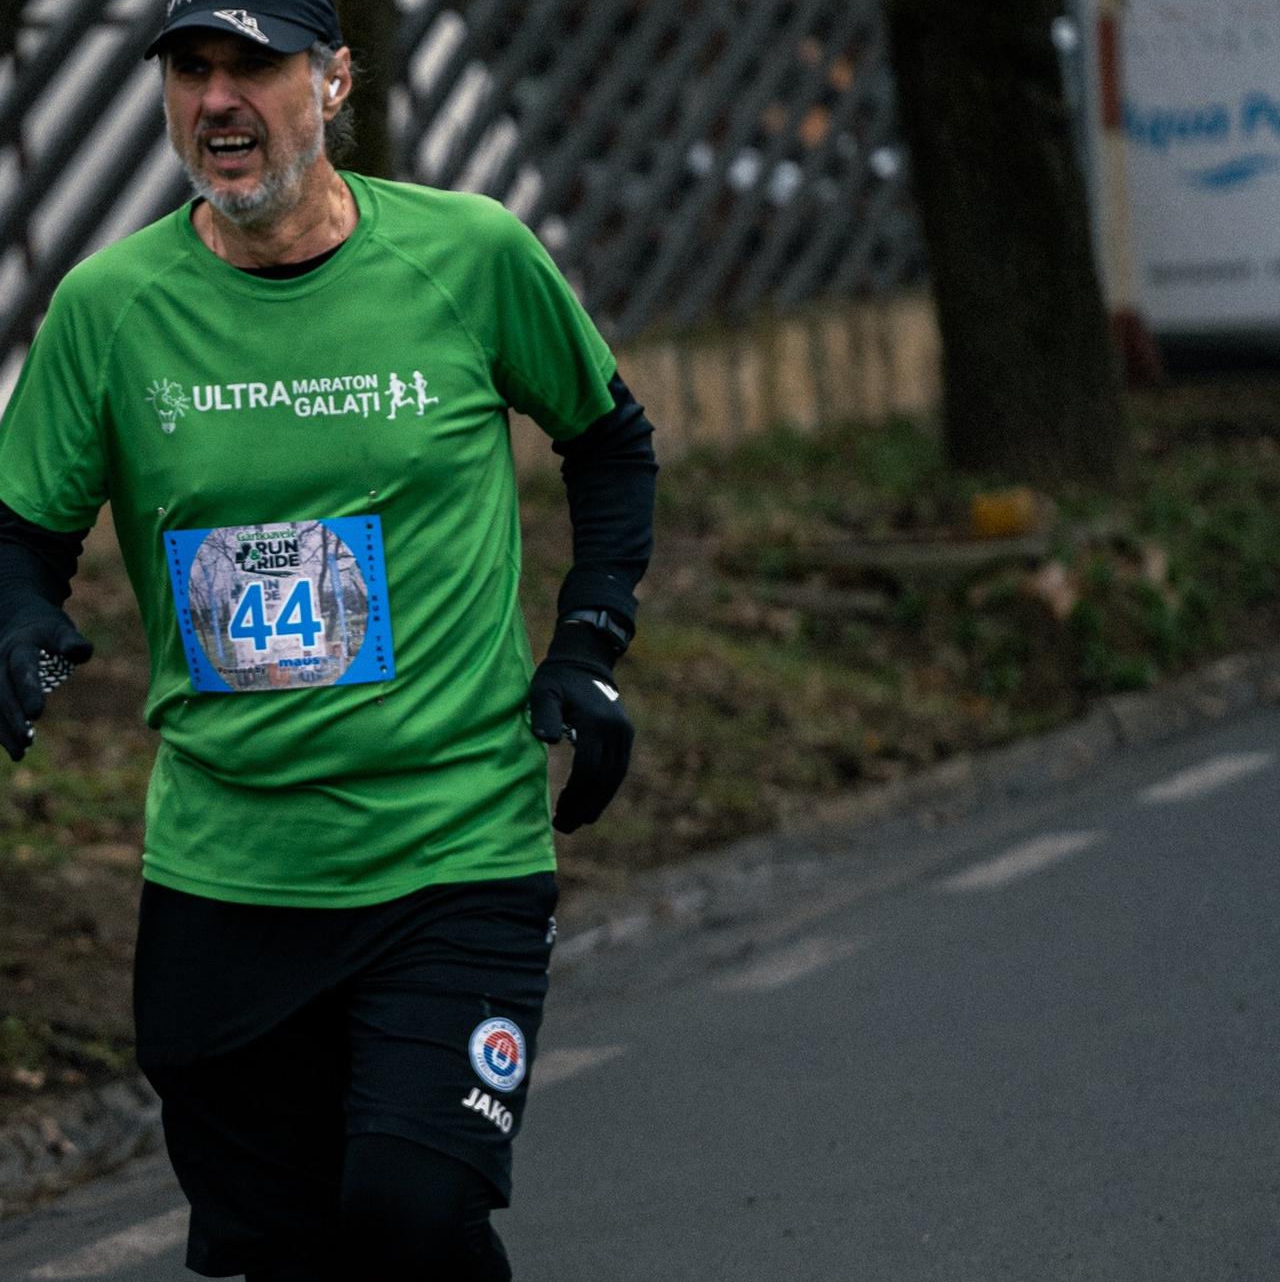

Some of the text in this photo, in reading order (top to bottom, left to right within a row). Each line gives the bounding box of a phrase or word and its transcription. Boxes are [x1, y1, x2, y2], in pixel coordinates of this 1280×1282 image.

[192, 373, 379, 411] ULTRA MARATON
[255, 539, 299, 555] RUN
[257, 553, 300, 569] RIDE
[230, 579, 323, 651] 44
[278, 657, 320, 667] maus
[461, 1087, 513, 1133] JAKO
